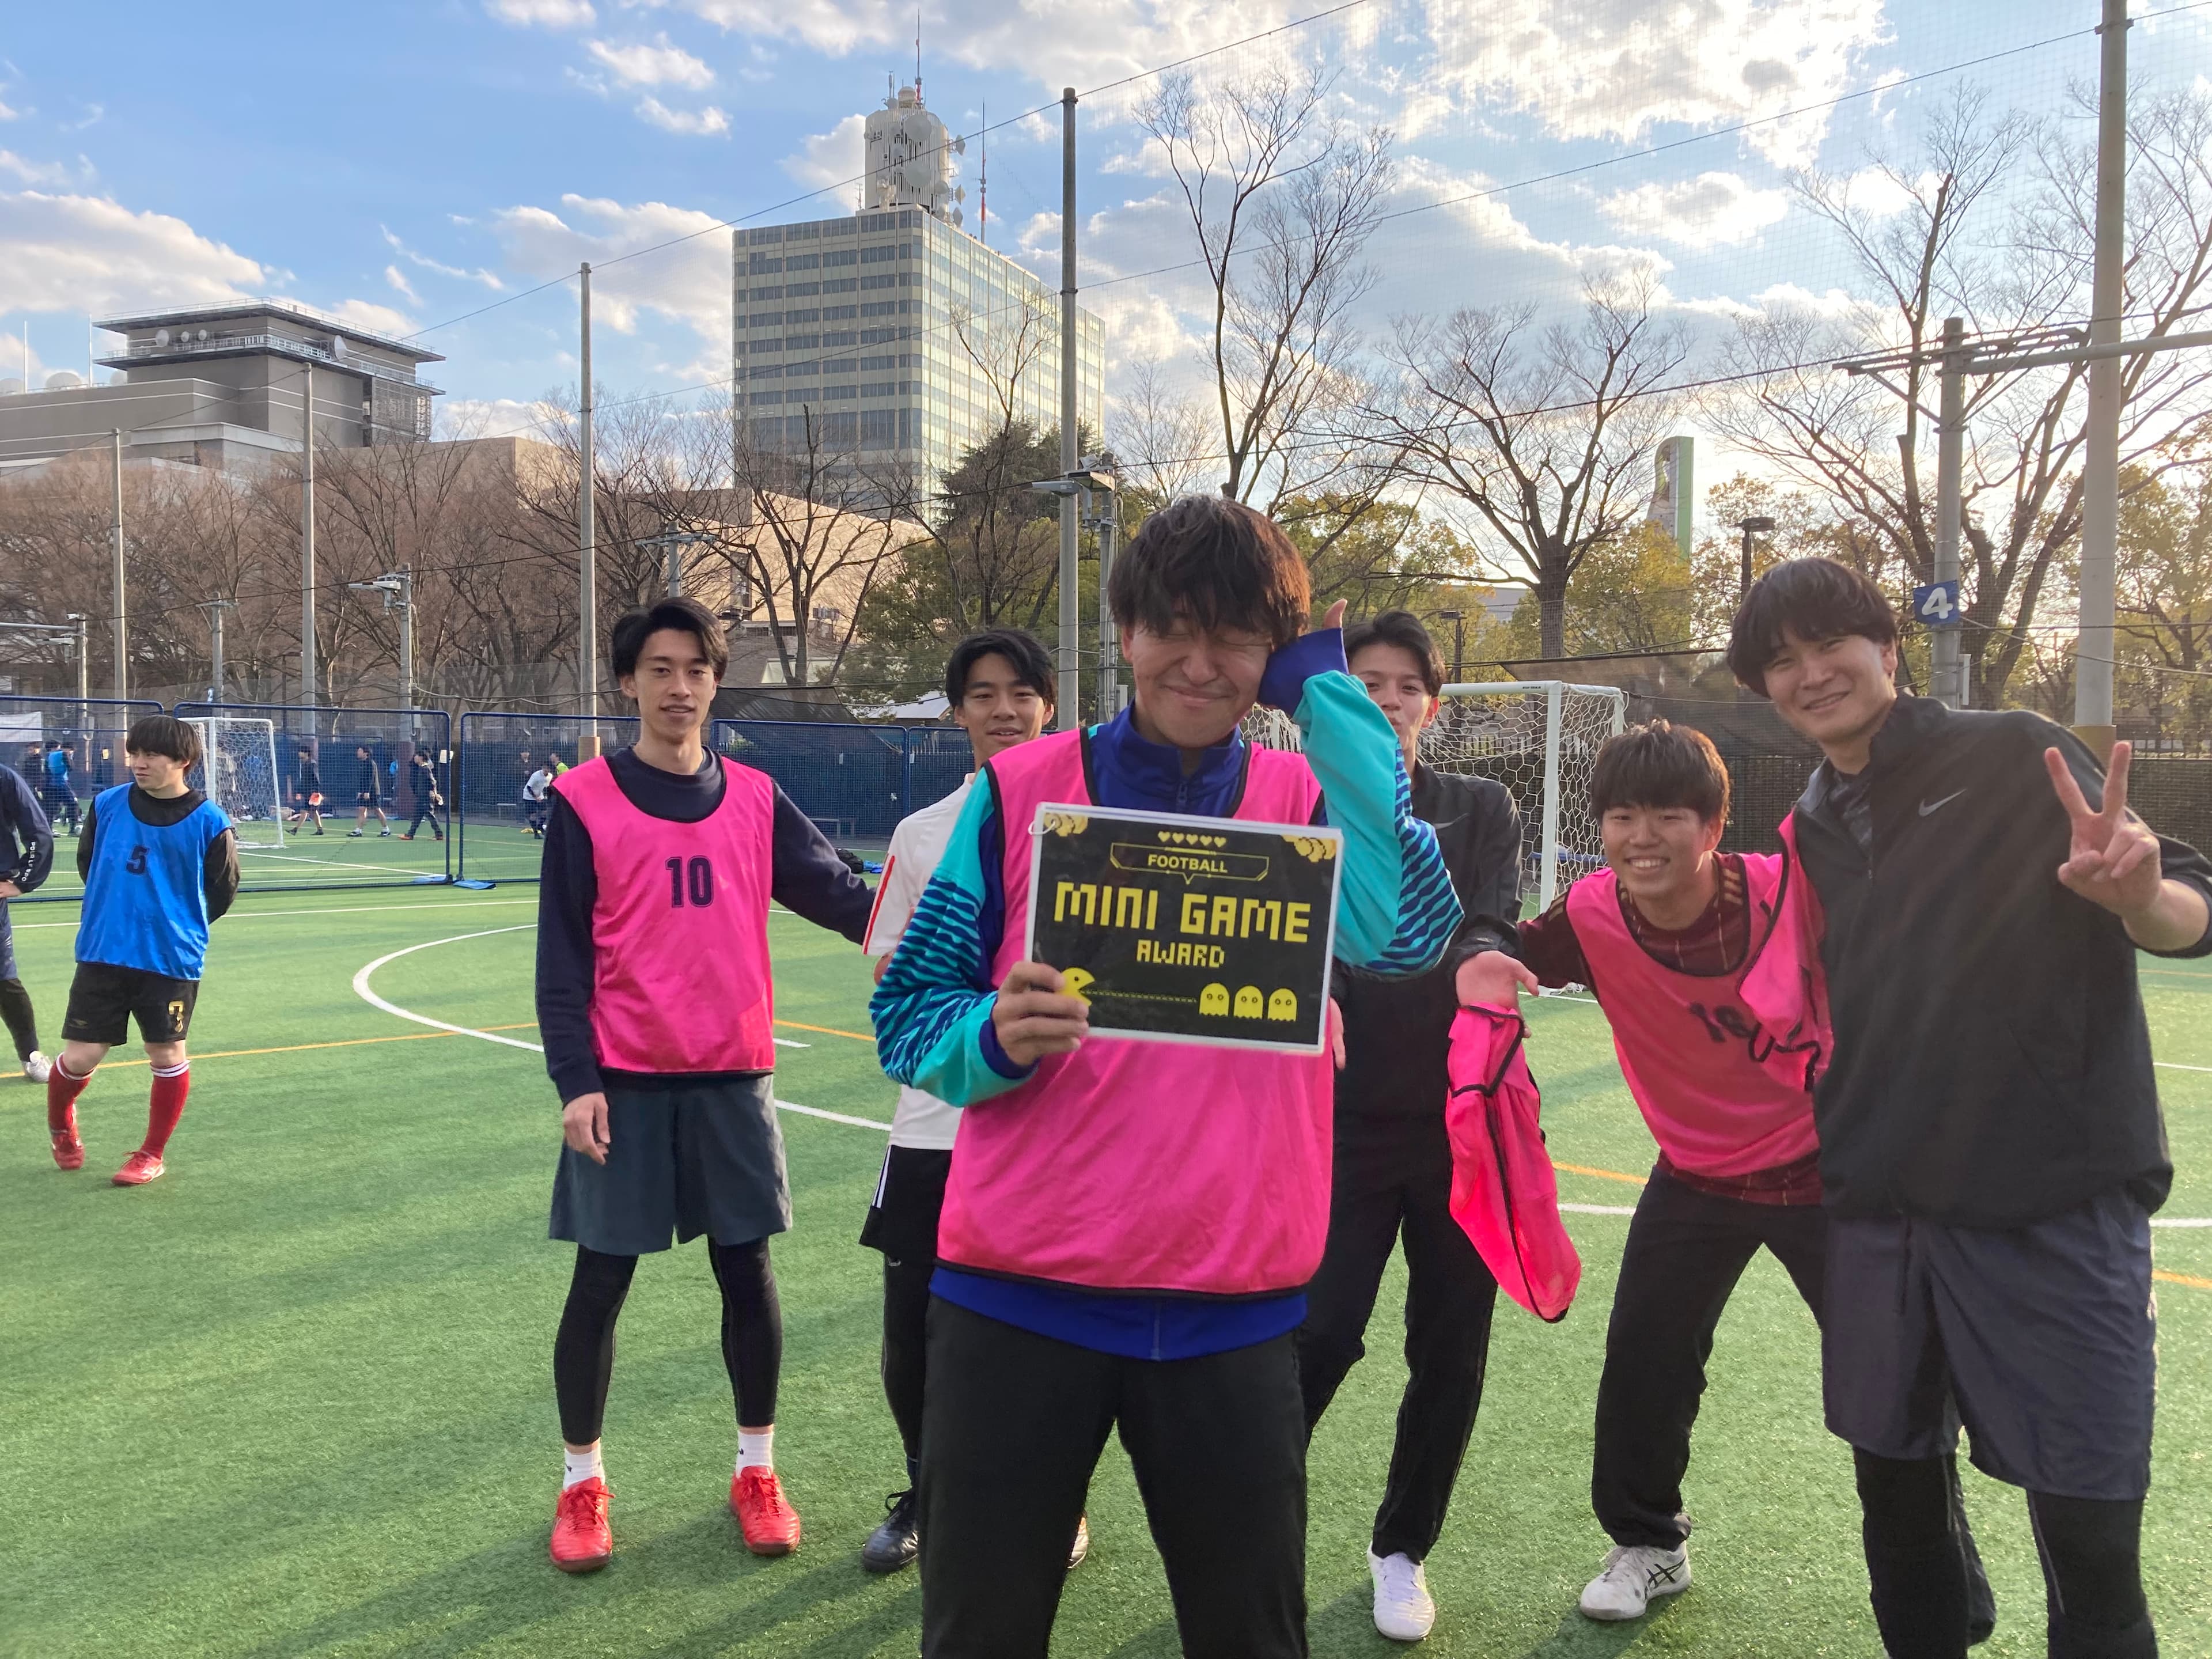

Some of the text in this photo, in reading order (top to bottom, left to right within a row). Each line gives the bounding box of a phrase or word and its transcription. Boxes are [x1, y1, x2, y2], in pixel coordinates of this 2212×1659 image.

[1922, 587, 1953, 619] 4
[126, 844, 149, 874] 5
[1148, 854, 1228, 873] FOOTBALL
[665, 855, 714, 908] 10
[1054, 881, 1312, 942] MINI GAME
[1137, 939, 1225, 968] AWARD
